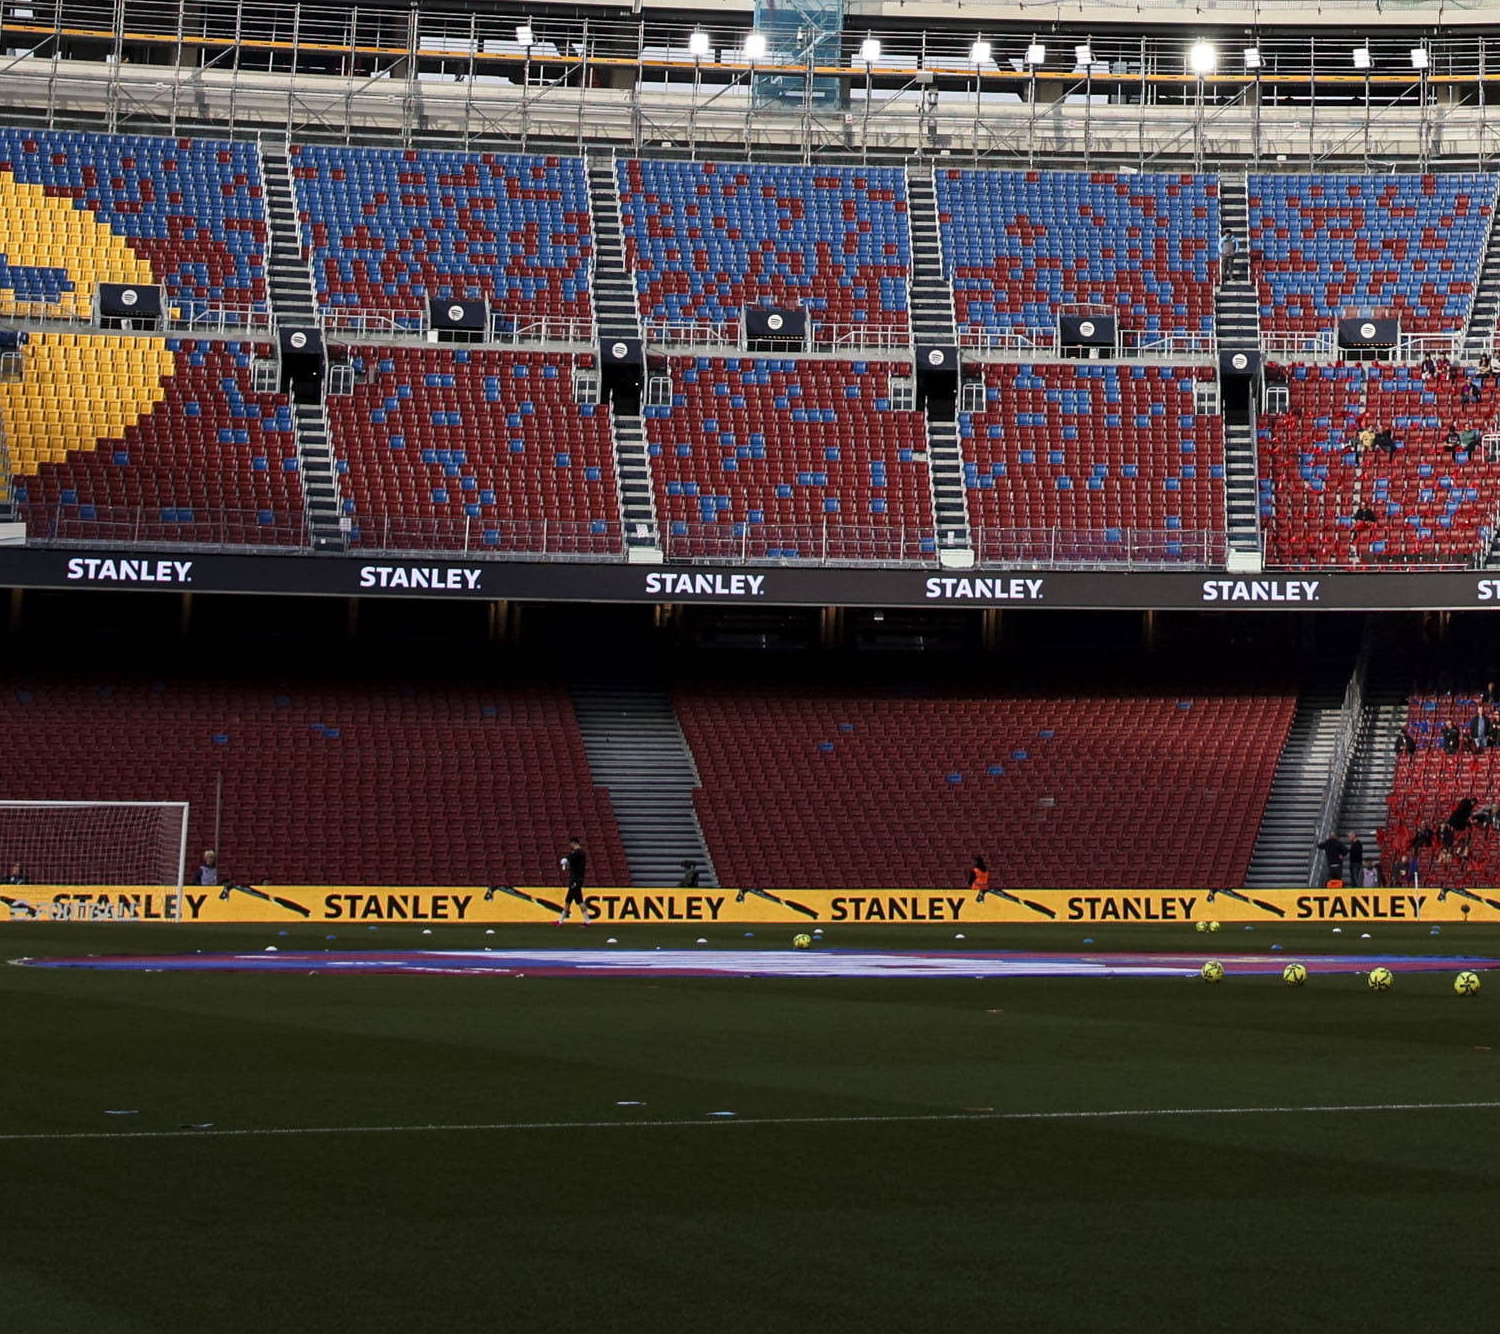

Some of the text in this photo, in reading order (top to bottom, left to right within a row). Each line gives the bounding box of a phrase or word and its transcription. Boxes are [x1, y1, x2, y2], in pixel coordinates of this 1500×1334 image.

[325, 895, 471, 919] STANLEY
[585, 896, 725, 920] STANLEY
[831, 897, 965, 921] STANLEY
[1068, 897, 1196, 921] STANLEY
[1297, 897, 1425, 920] STANLEY
